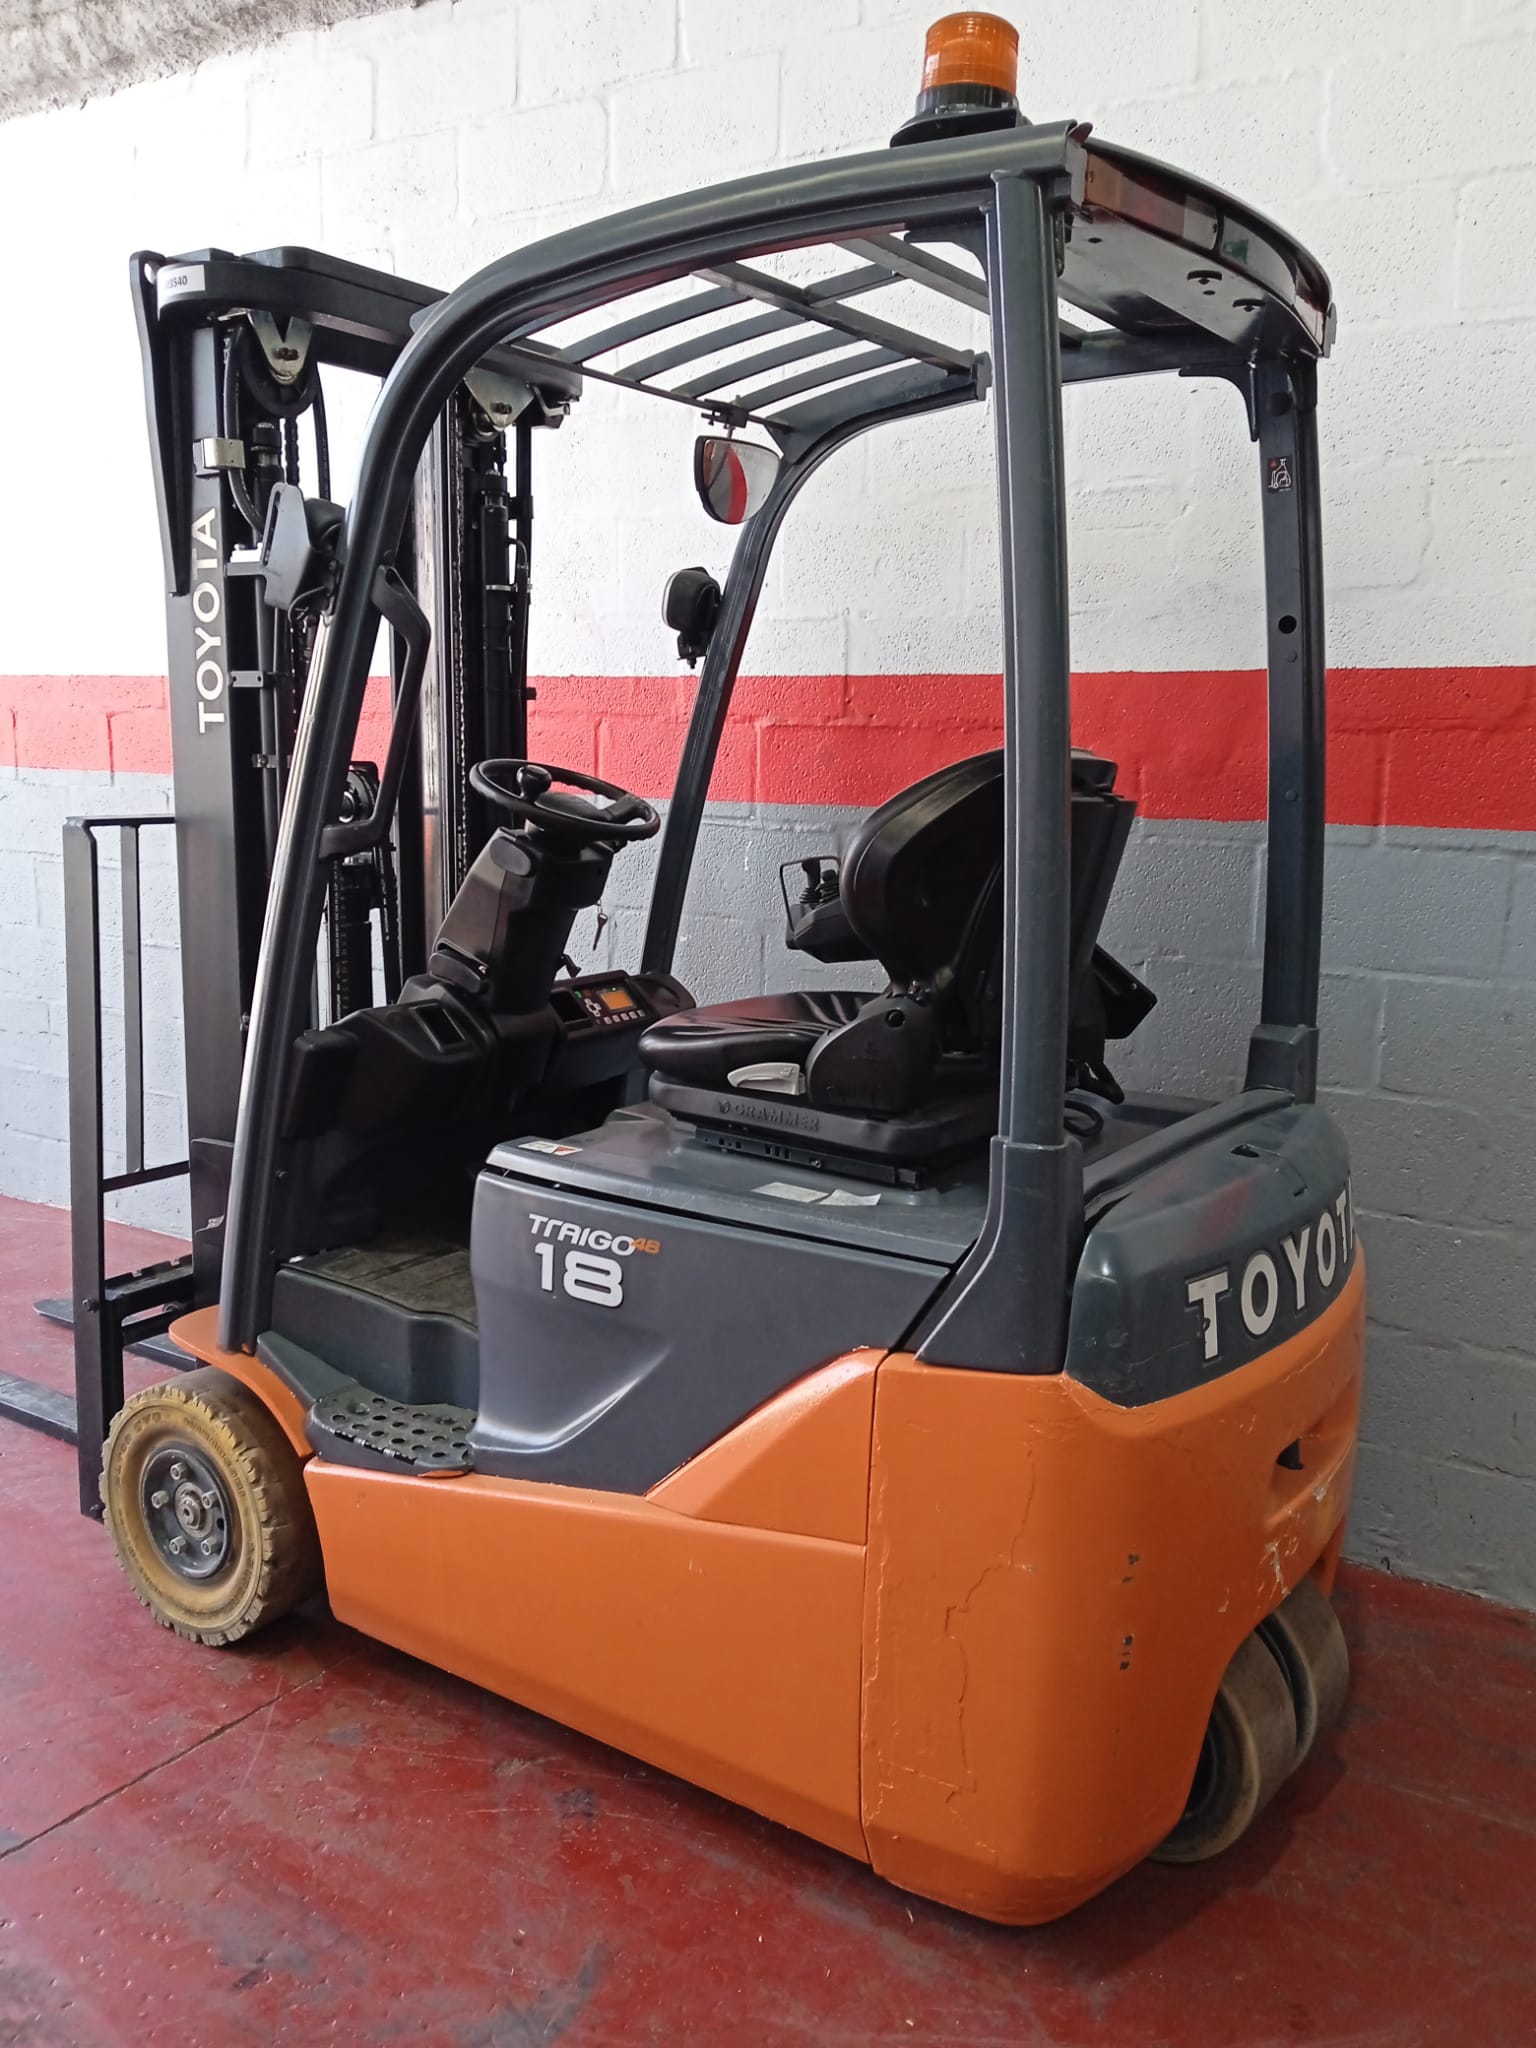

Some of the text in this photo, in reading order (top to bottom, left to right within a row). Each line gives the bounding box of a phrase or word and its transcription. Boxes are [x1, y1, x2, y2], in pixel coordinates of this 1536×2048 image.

[191, 507, 225, 734] TOYOTA
[735, 1103, 820, 1132] GRAMMER
[528, 1213, 636, 1256] TRAIGO
[534, 1242, 624, 1308] 18
